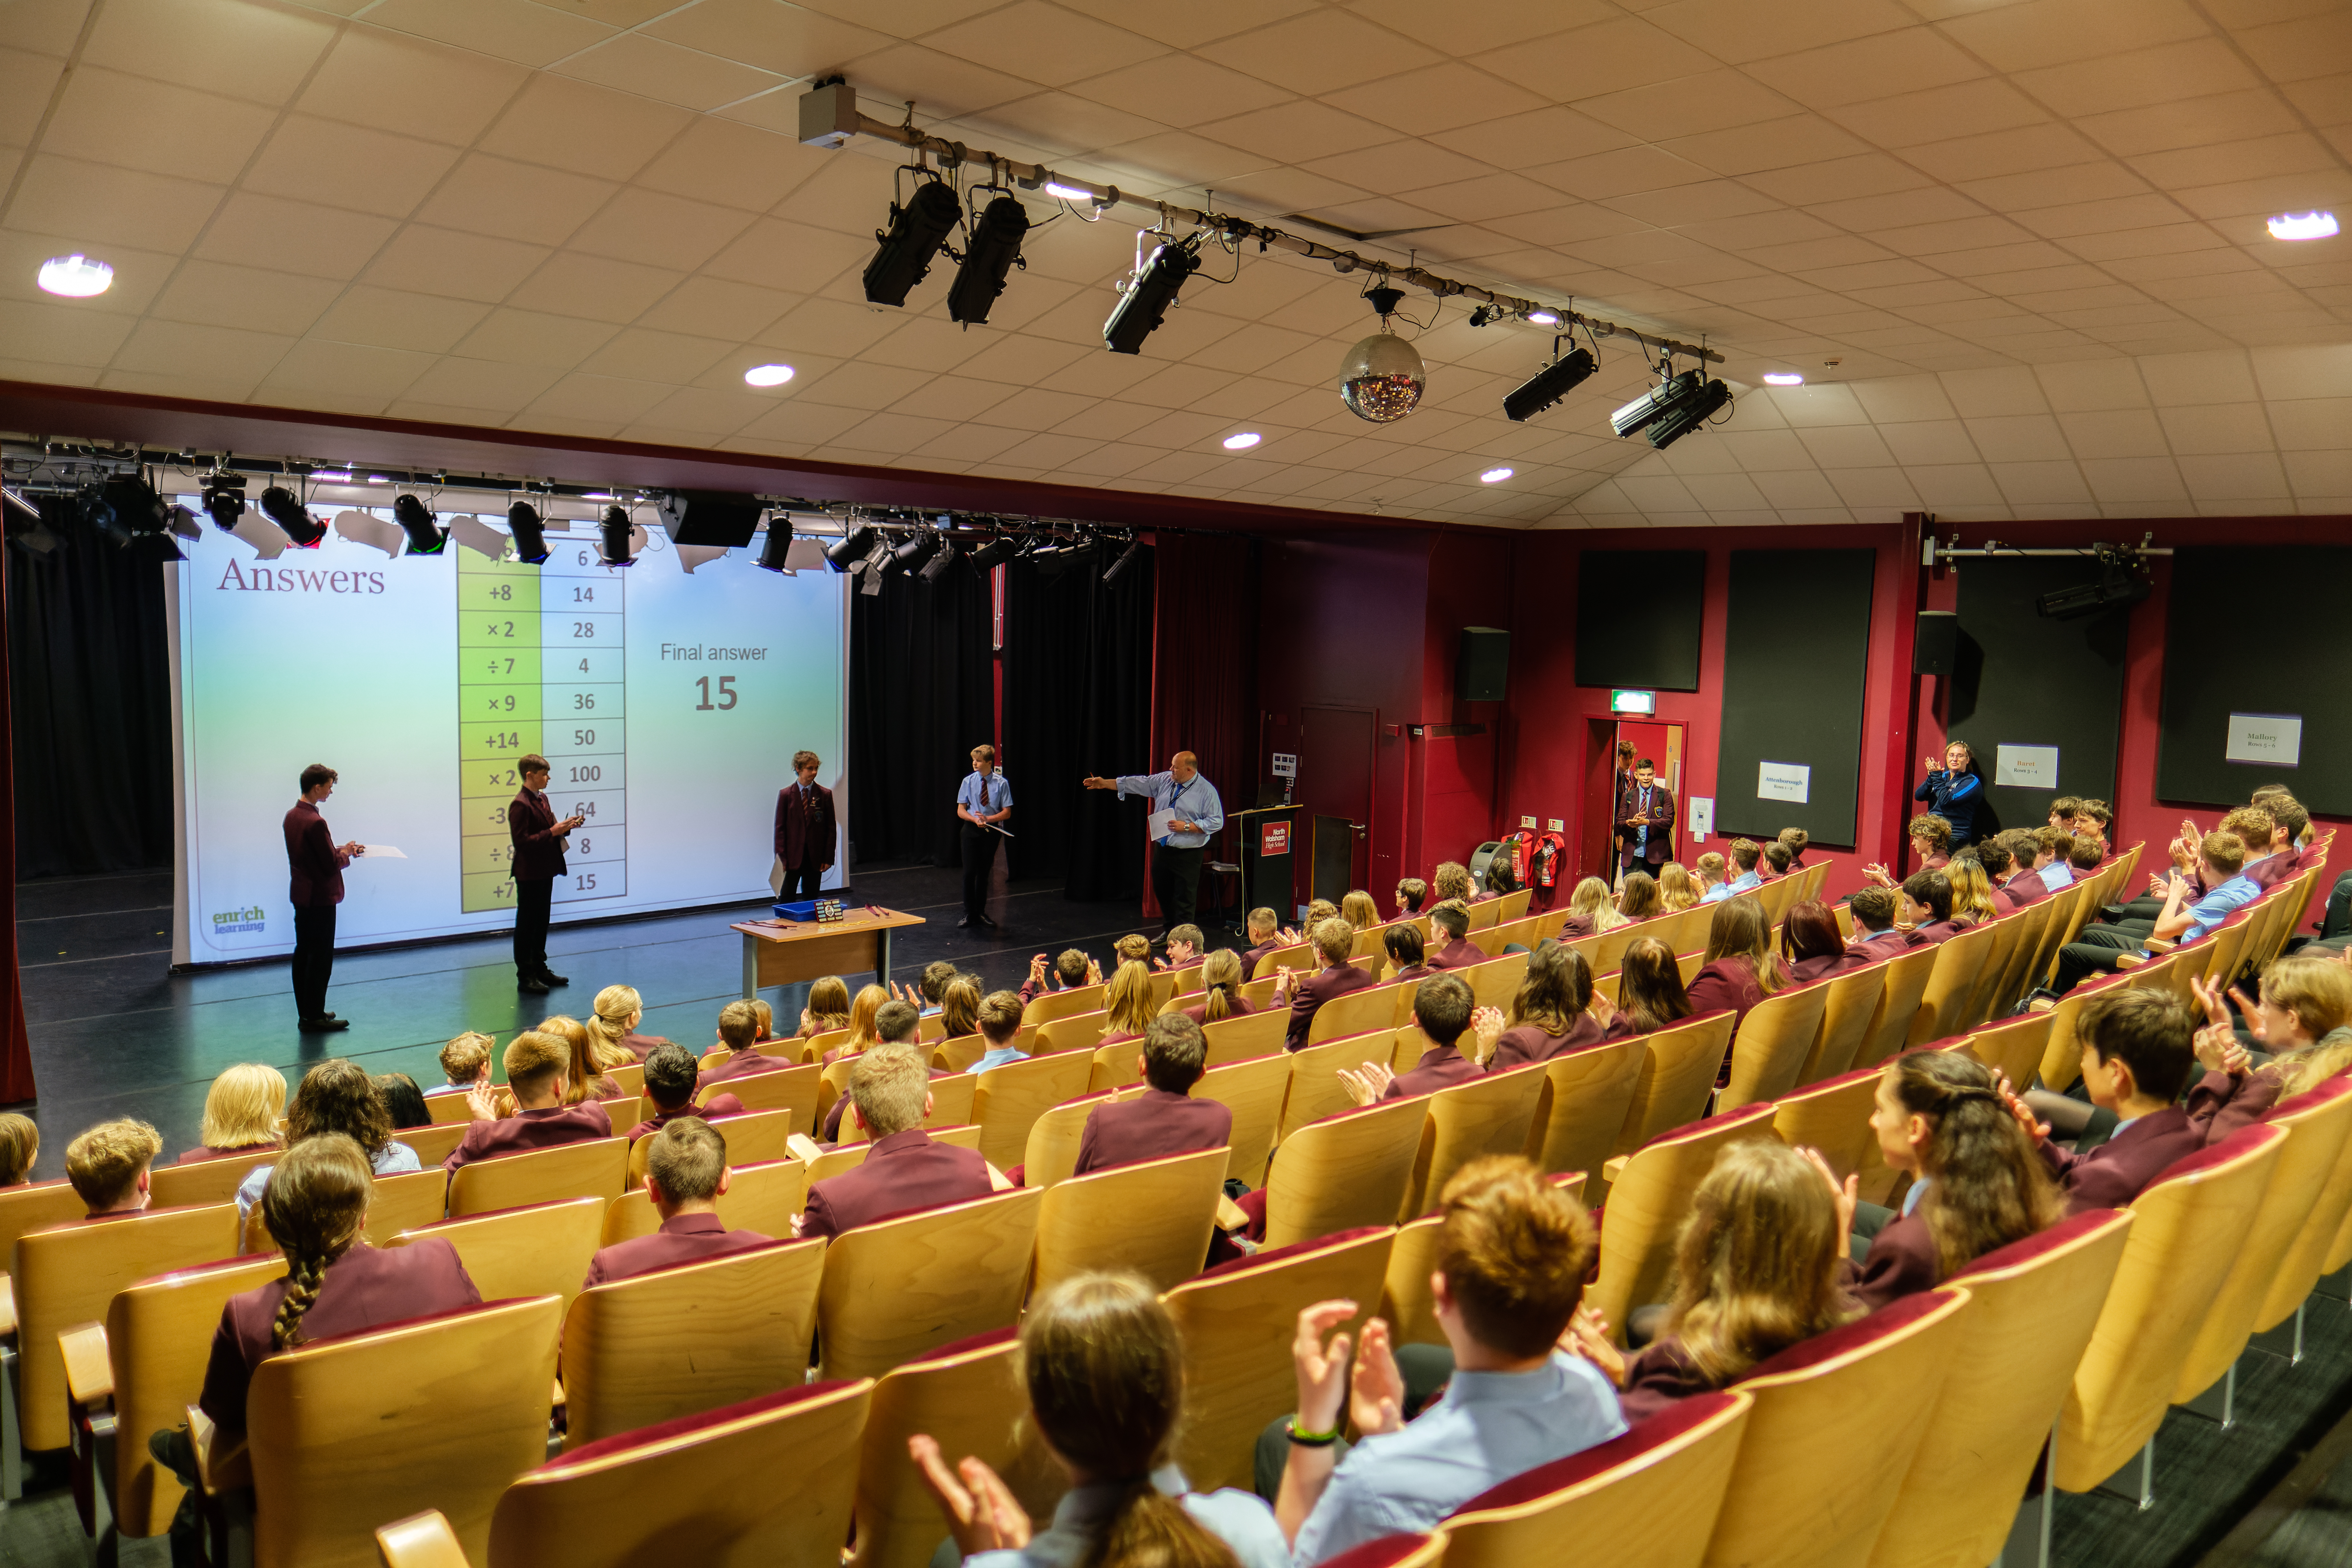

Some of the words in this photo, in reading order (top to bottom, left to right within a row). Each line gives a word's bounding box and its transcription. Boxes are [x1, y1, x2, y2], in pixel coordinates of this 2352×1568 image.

[578, 551, 588, 566] 6
[216, 557, 384, 594] Answers
[489, 584, 512, 601] +8
[573, 587, 594, 602] 14
[504, 621, 514, 637] 2
[573, 622, 594, 638] 28
[662, 643, 702, 660] Final
[708, 648, 768, 660] answer
[504, 658, 515, 674] 7
[579, 658, 589, 673] 4
[695, 676, 737, 710] 15
[504, 695, 515, 711] 9
[574, 694, 595, 709] 36
[485, 732, 519, 749] +14
[574, 729, 595, 746] 50
[2248, 733, 2277, 742] Mallory
[505, 770, 516, 786] 2
[570, 766, 601, 782] 100
[1766, 777, 1803, 786] Attenborough
[576, 802, 596, 817] 64
[581, 838, 591, 854] 8
[493, 882, 514, 899] +7
[576, 874, 596, 891] 15
[213, 906, 265, 923] enrich
[214, 922, 265, 934] learning
